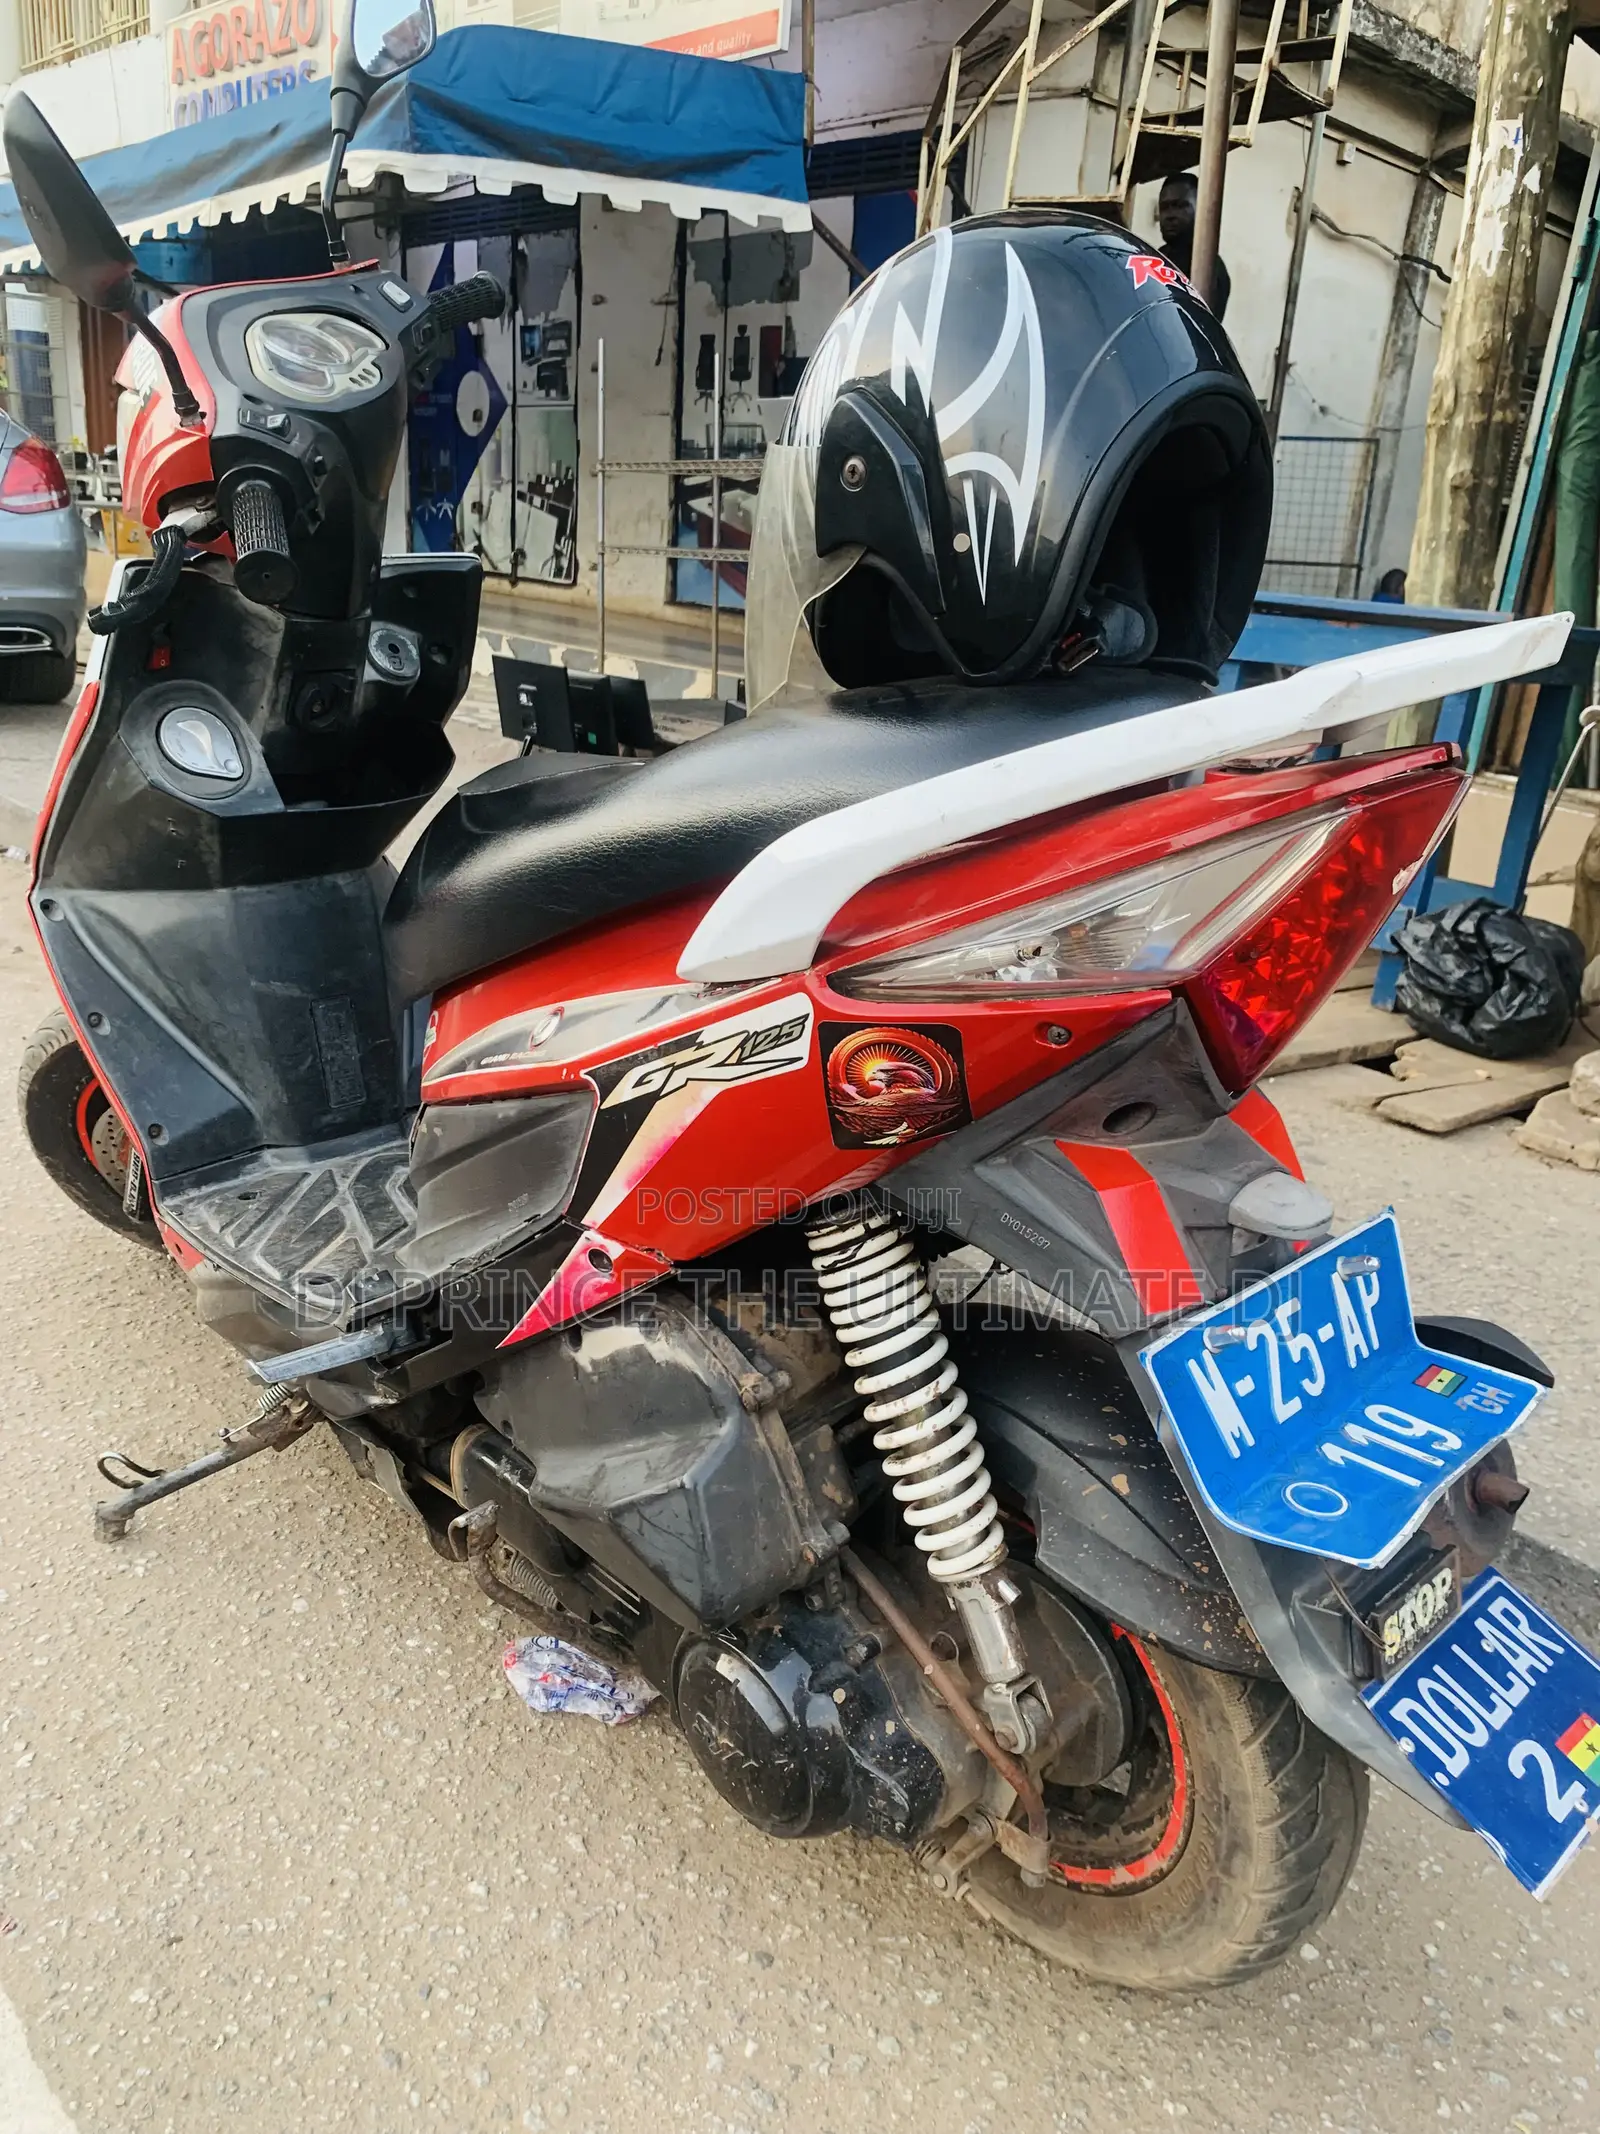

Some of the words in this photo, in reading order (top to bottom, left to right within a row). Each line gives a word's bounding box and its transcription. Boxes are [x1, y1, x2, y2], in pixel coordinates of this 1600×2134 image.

[171, 0, 320, 85] AGORAZO
[717, 29, 752, 53] quality
[739, 1012, 811, 1061] 125
[1186, 1270, 1380, 1459] M-25-AP
[1319, 1404, 1463, 1487] 119
[1462, 1381, 1517, 1416] GH
[1383, 1567, 1452, 1658] STOP
[1508, 1739, 1586, 1824] 2
